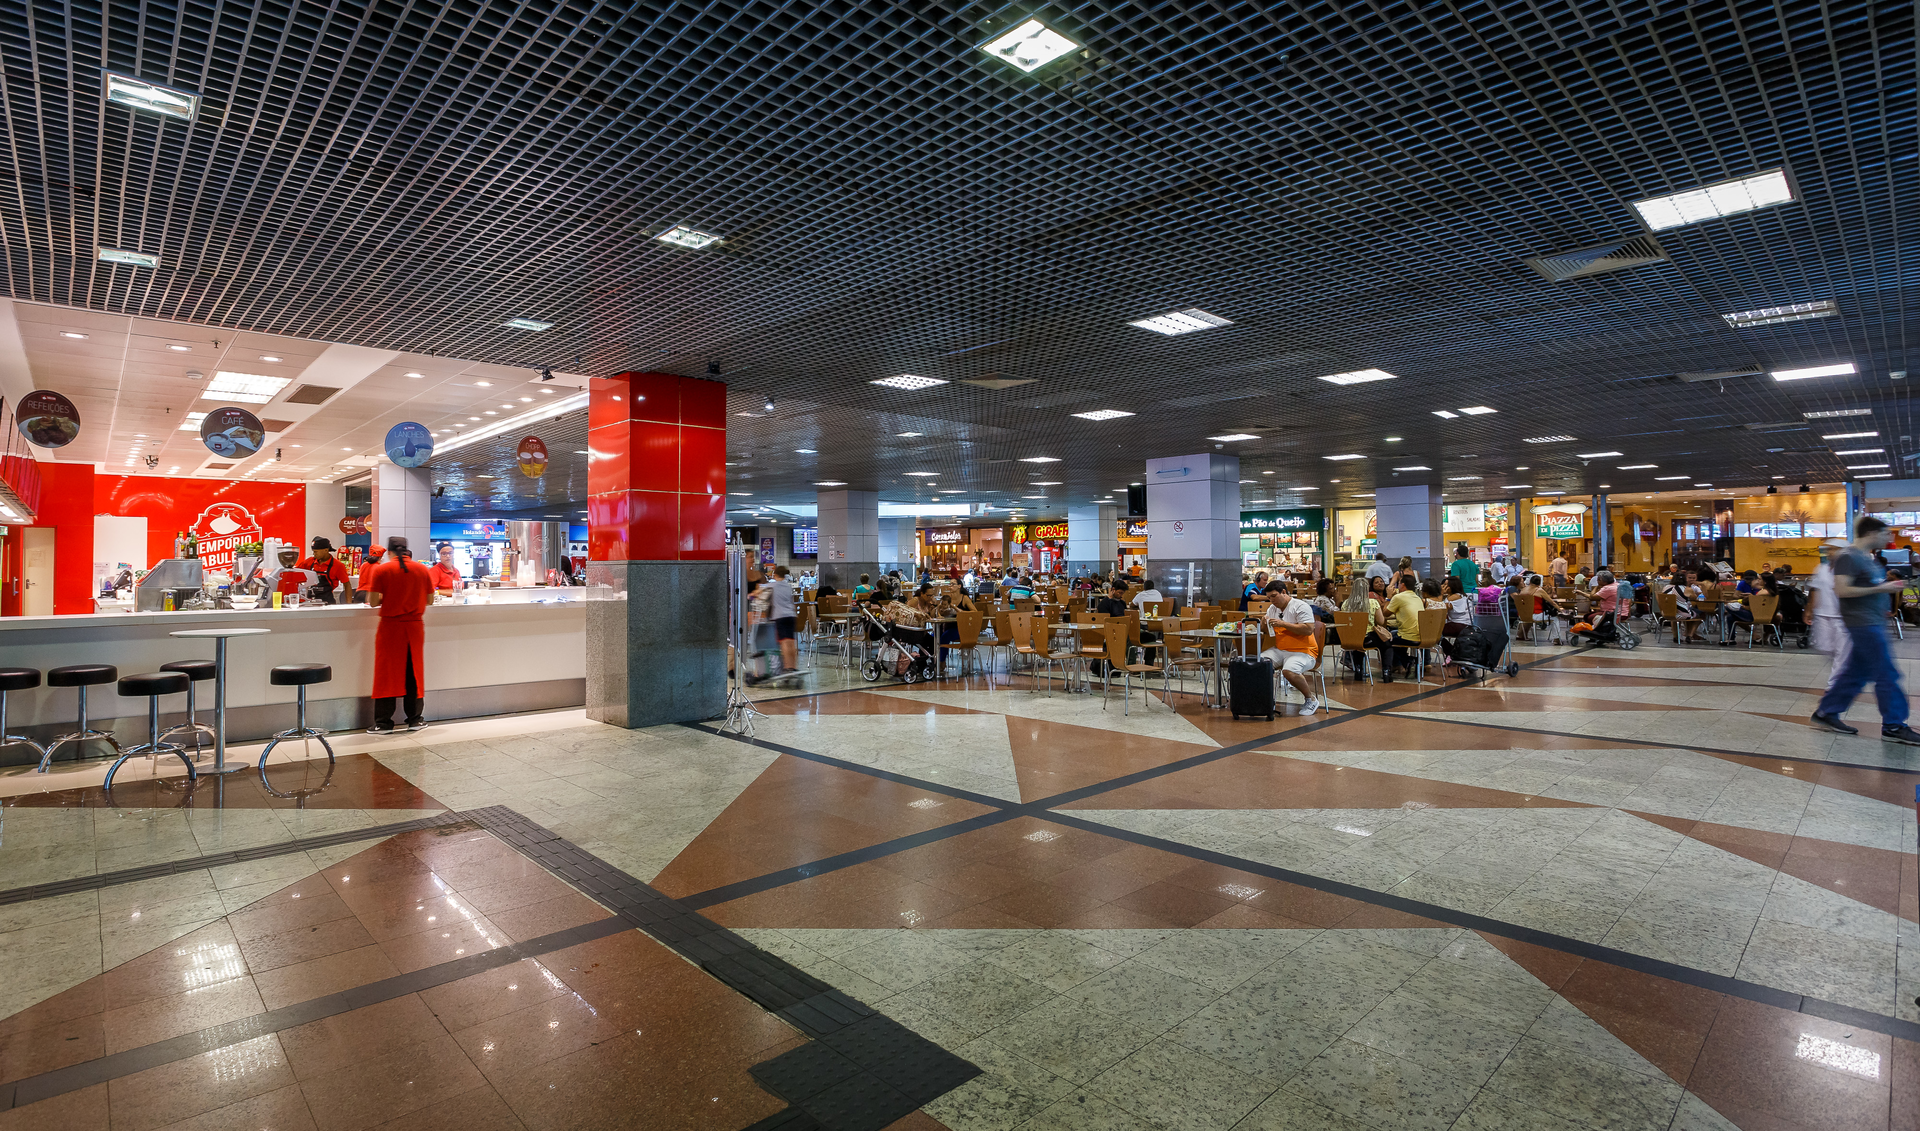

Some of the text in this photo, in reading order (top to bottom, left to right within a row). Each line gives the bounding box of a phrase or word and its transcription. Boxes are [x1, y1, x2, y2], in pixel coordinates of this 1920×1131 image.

[27, 400, 70, 414] REFEIÇÕES
[221, 416, 244, 426] CAFÉ
[394, 430, 425, 438] LANCHES
[1252, 518, 1268, 528] Pão
[1276, 516, 1306, 529] Queijo
[1540, 514, 1579, 527] PIAZZA
[1550, 524, 1579, 537] PIZZA
